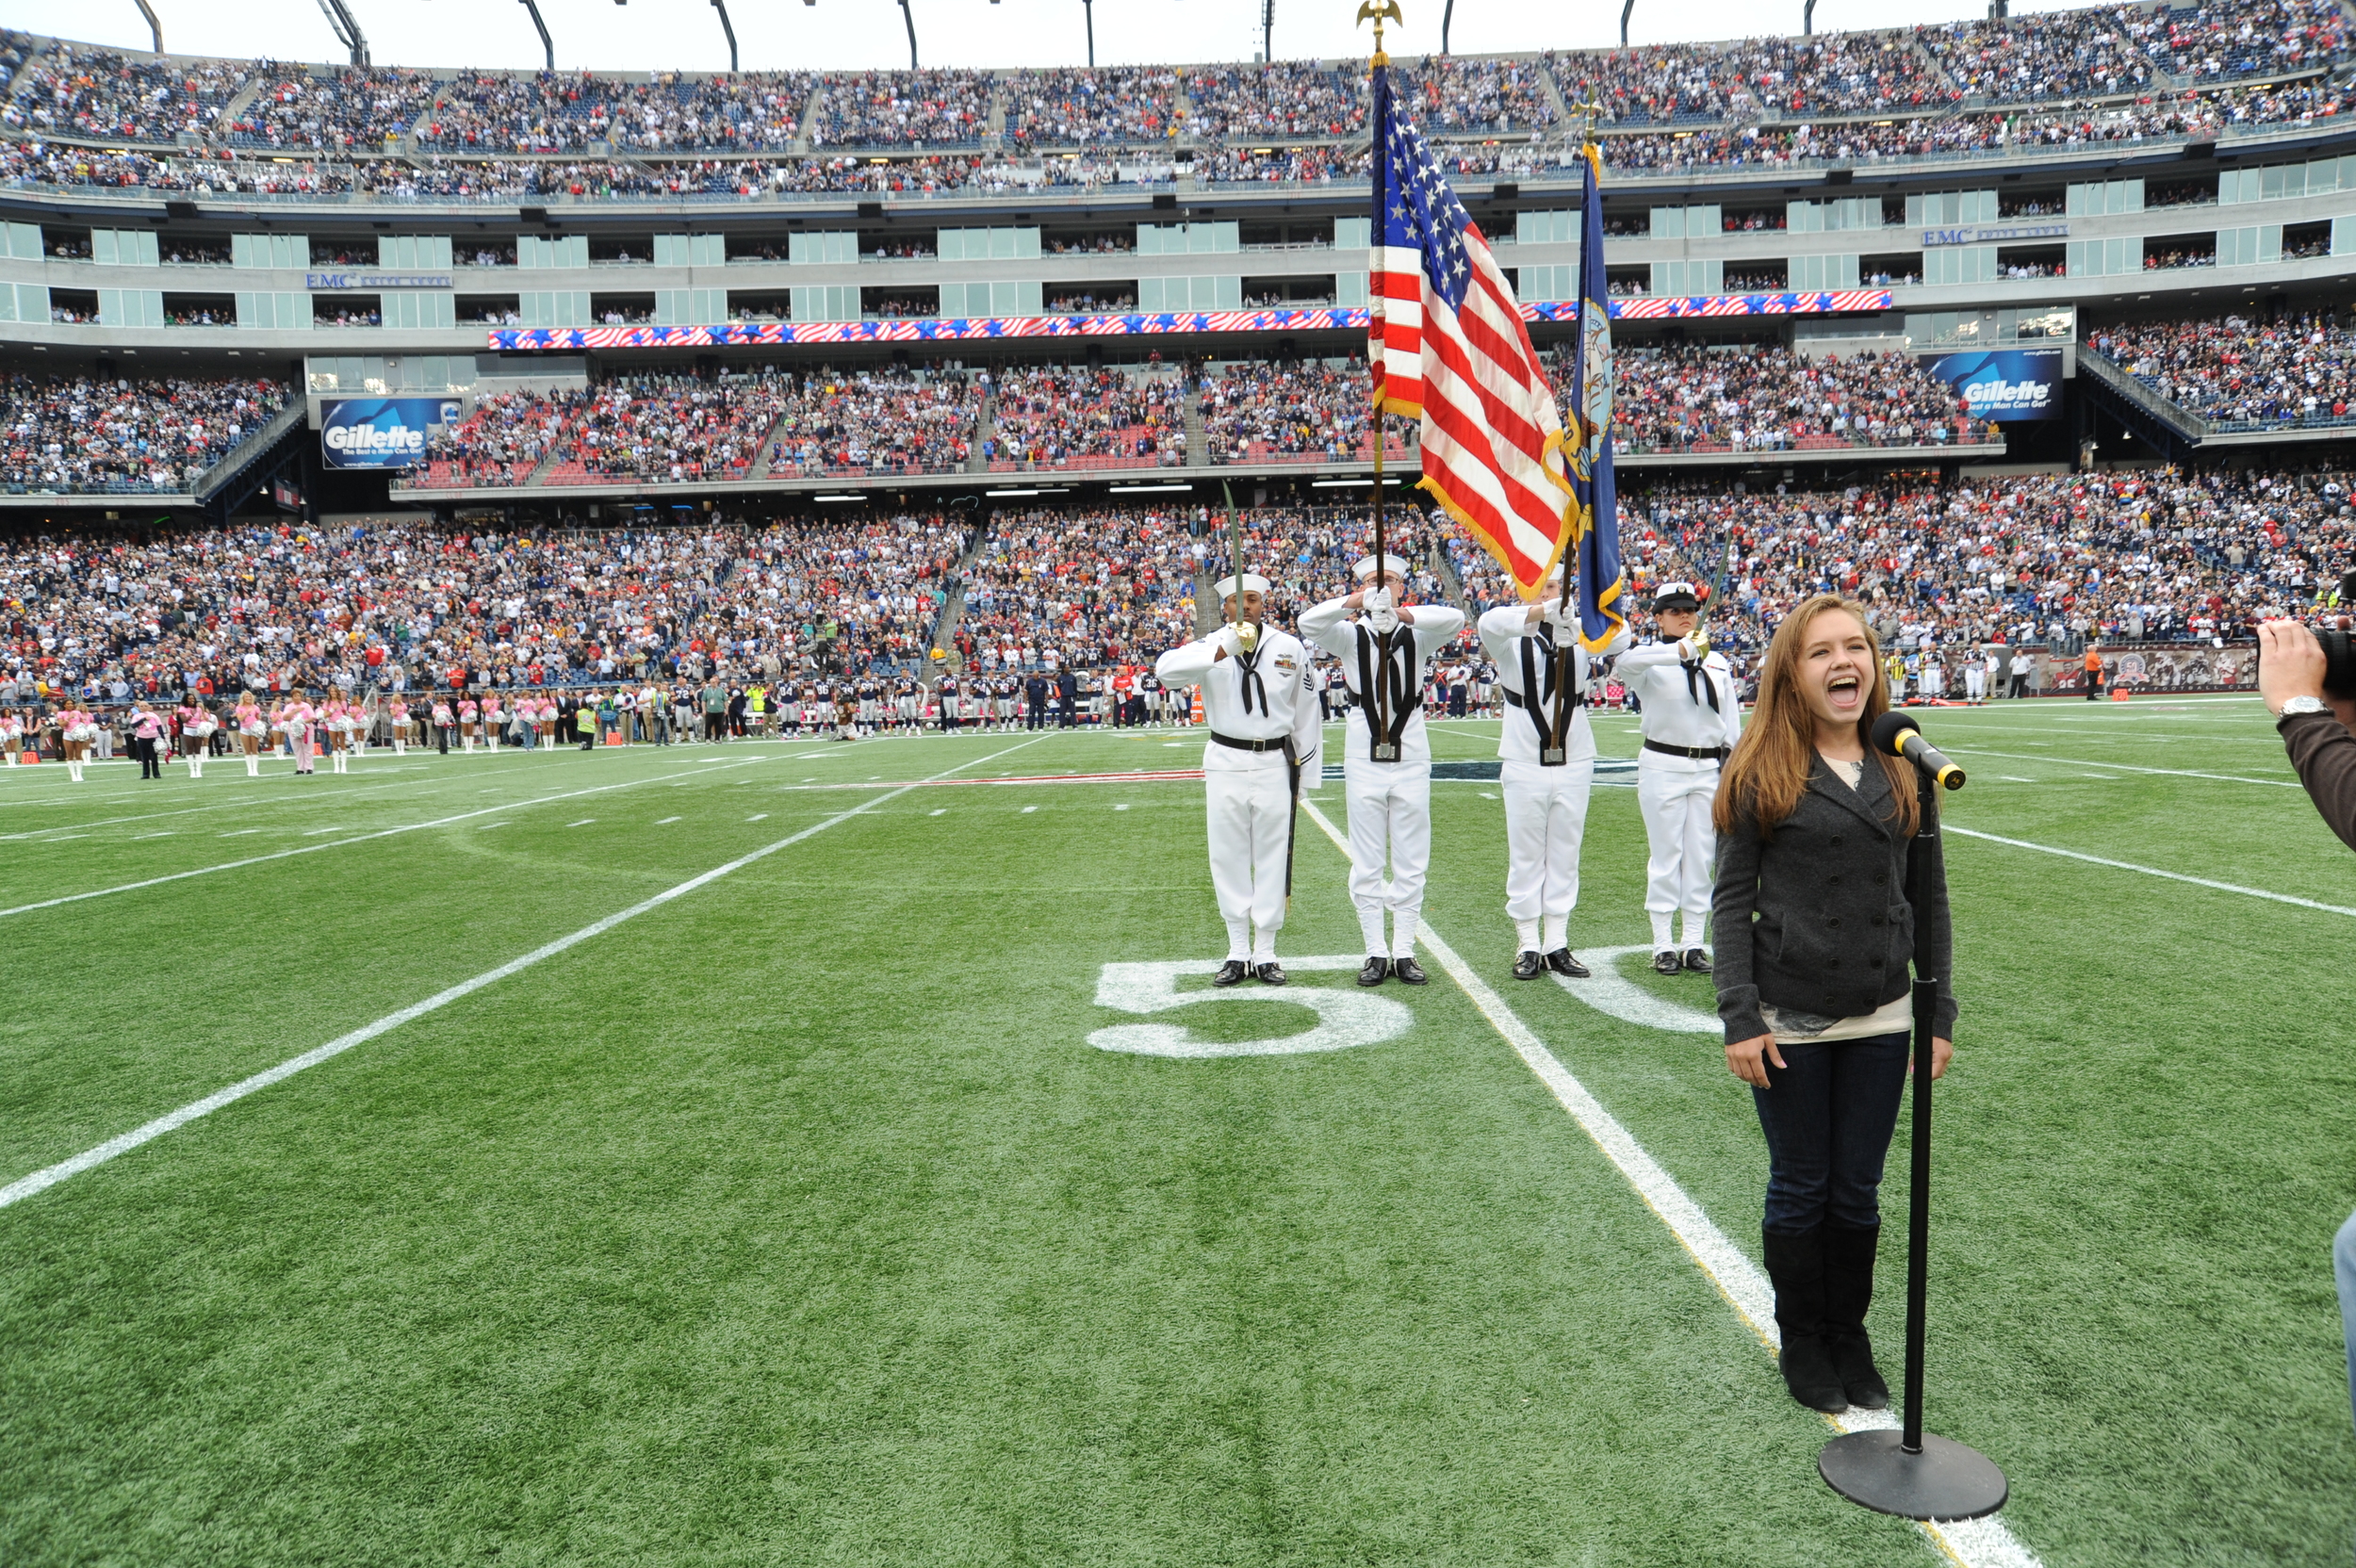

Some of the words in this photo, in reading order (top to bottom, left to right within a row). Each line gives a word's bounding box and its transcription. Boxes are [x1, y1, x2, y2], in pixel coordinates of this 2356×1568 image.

[1964, 380, 2049, 402] Gillette
[2031, 400, 2047, 408] Get
[325, 424, 423, 449] Gillette
[2220, 623, 2231, 631] 12
[1331, 672, 1342, 681] 23
[1145, 678, 1157, 688] 36
[779, 686, 793, 696] 84
[817, 684, 829, 694] 86
[676, 690, 689, 699] 72
[608, 734, 618, 744] 30
[24, 753, 34, 763] 10
